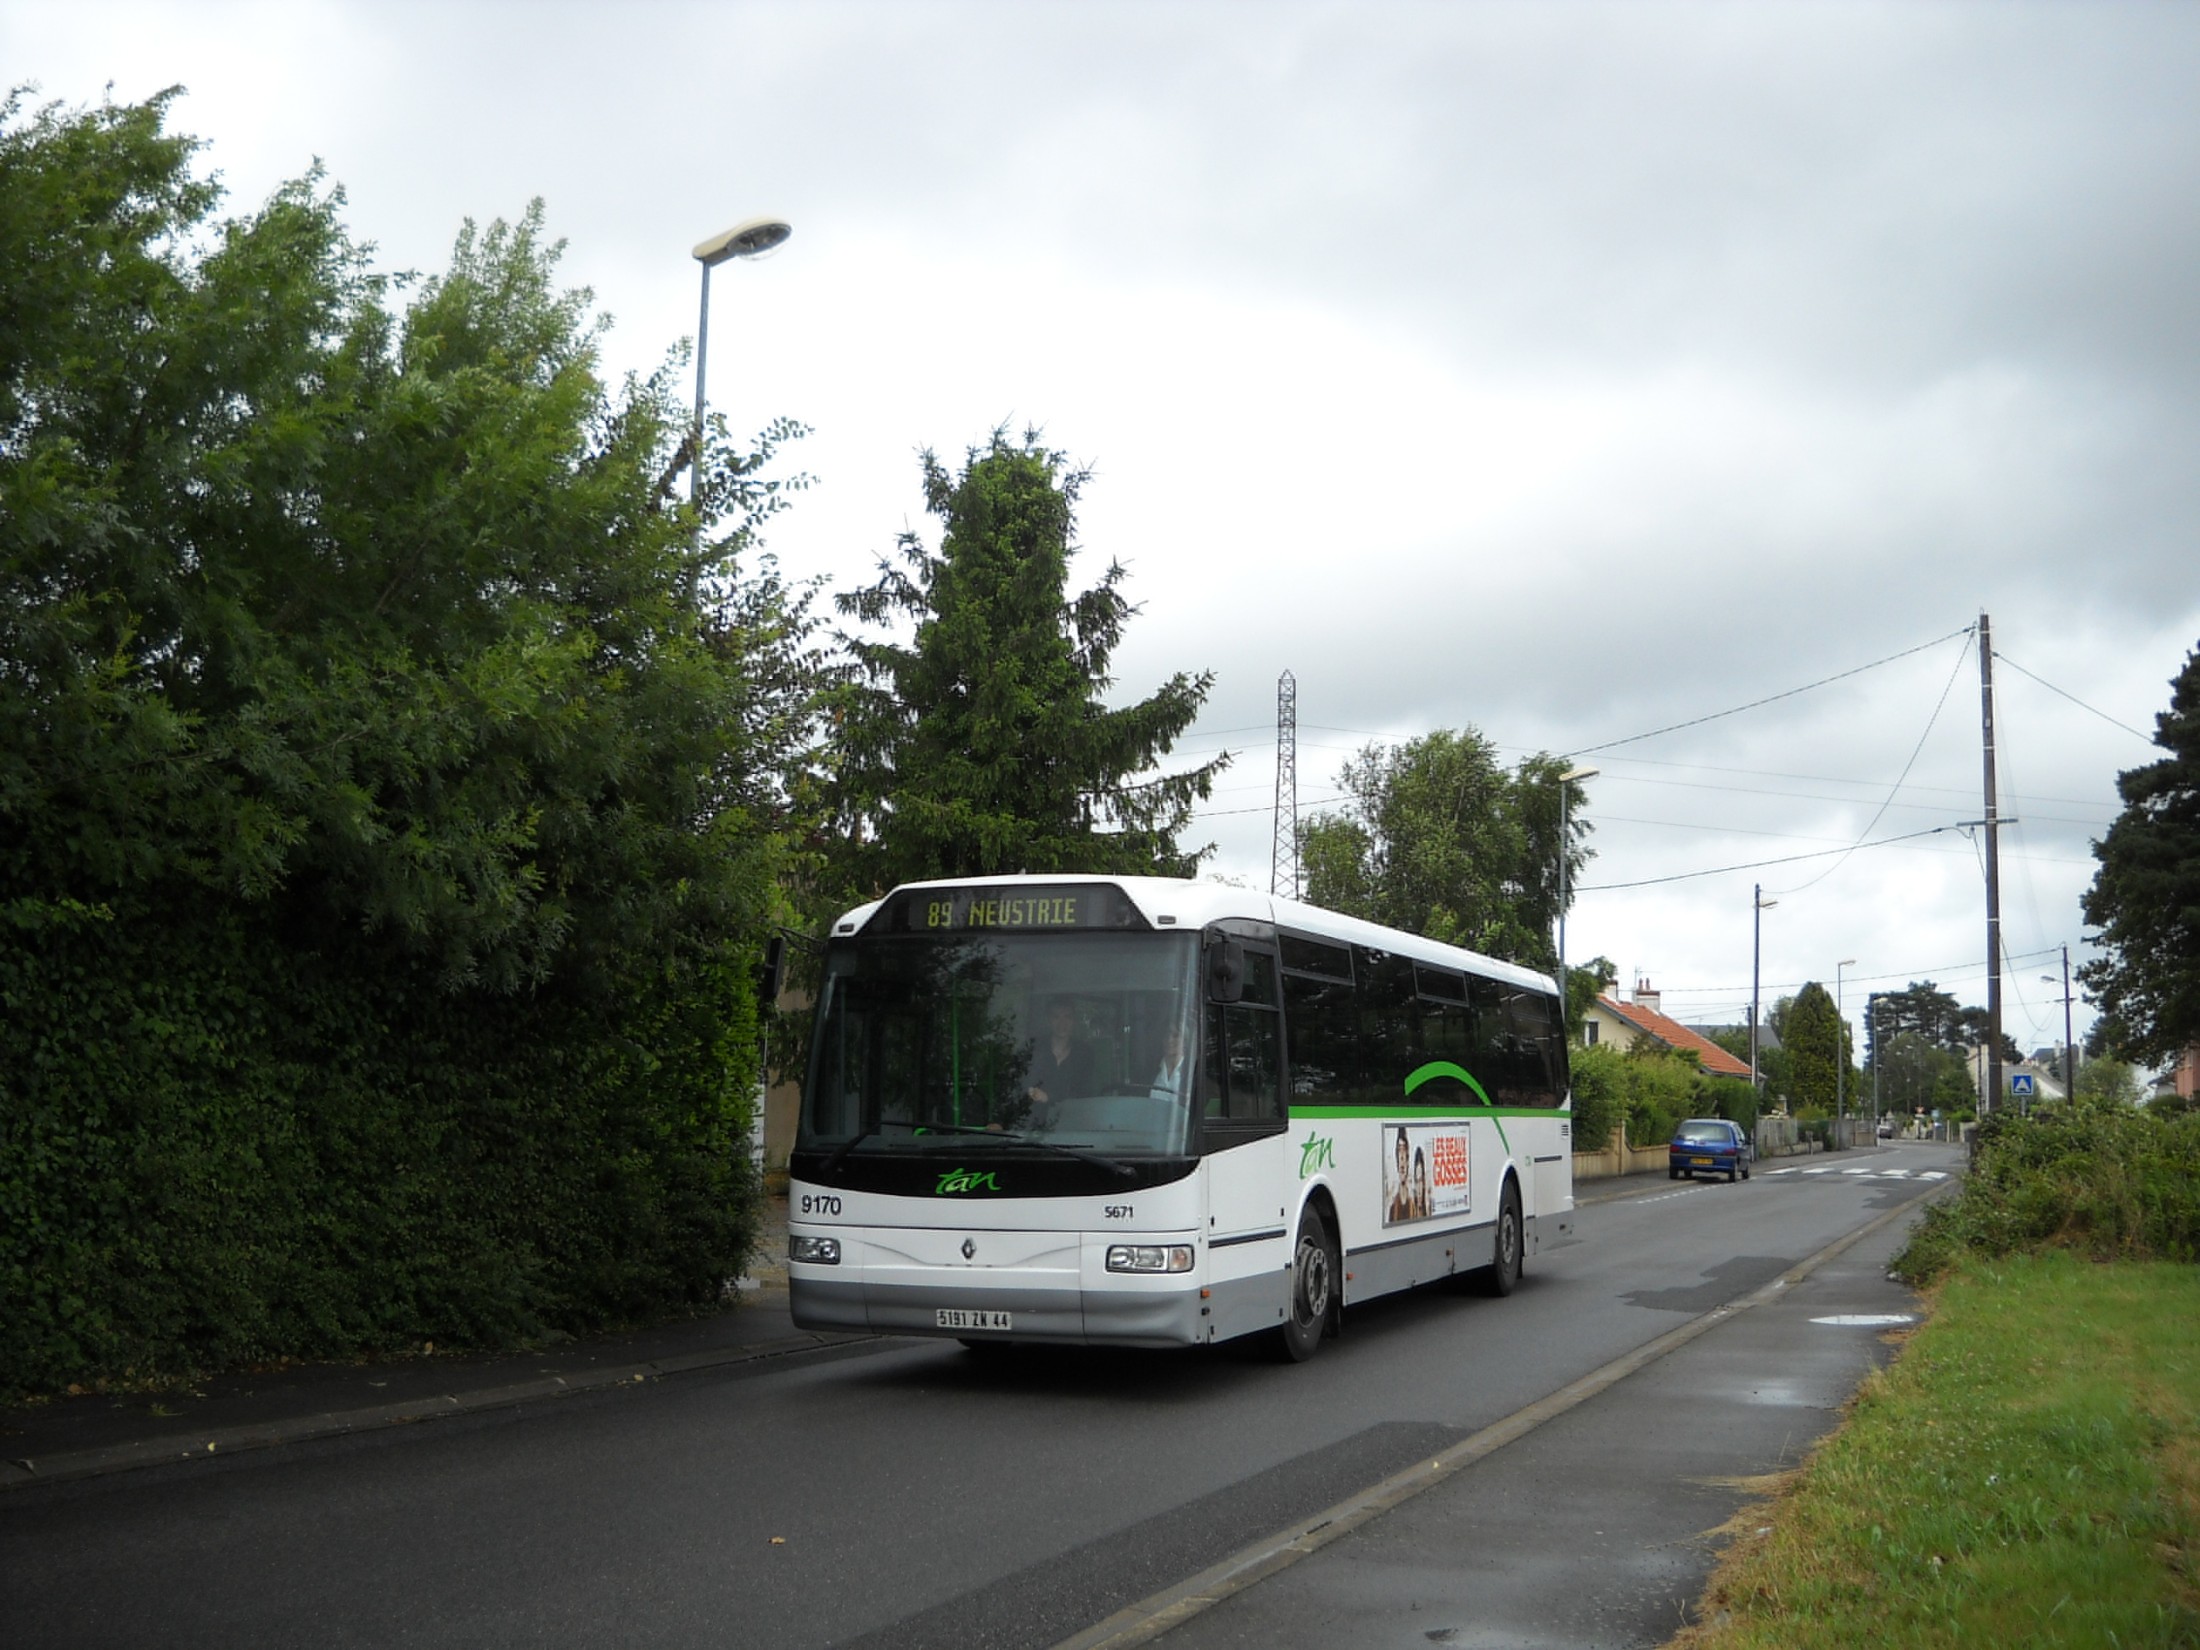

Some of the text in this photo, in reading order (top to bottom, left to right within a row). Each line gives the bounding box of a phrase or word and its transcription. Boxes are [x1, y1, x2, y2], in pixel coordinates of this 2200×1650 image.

[928, 898, 1076, 927] 89 NEUSTRIE
[937, 1168, 1001, 1194] tan
[801, 1195, 842, 1215] 9170
[1105, 1206, 1134, 1219] 5671
[940, 1311, 966, 1326] 5191
[993, 1313, 1008, 1328] 44
